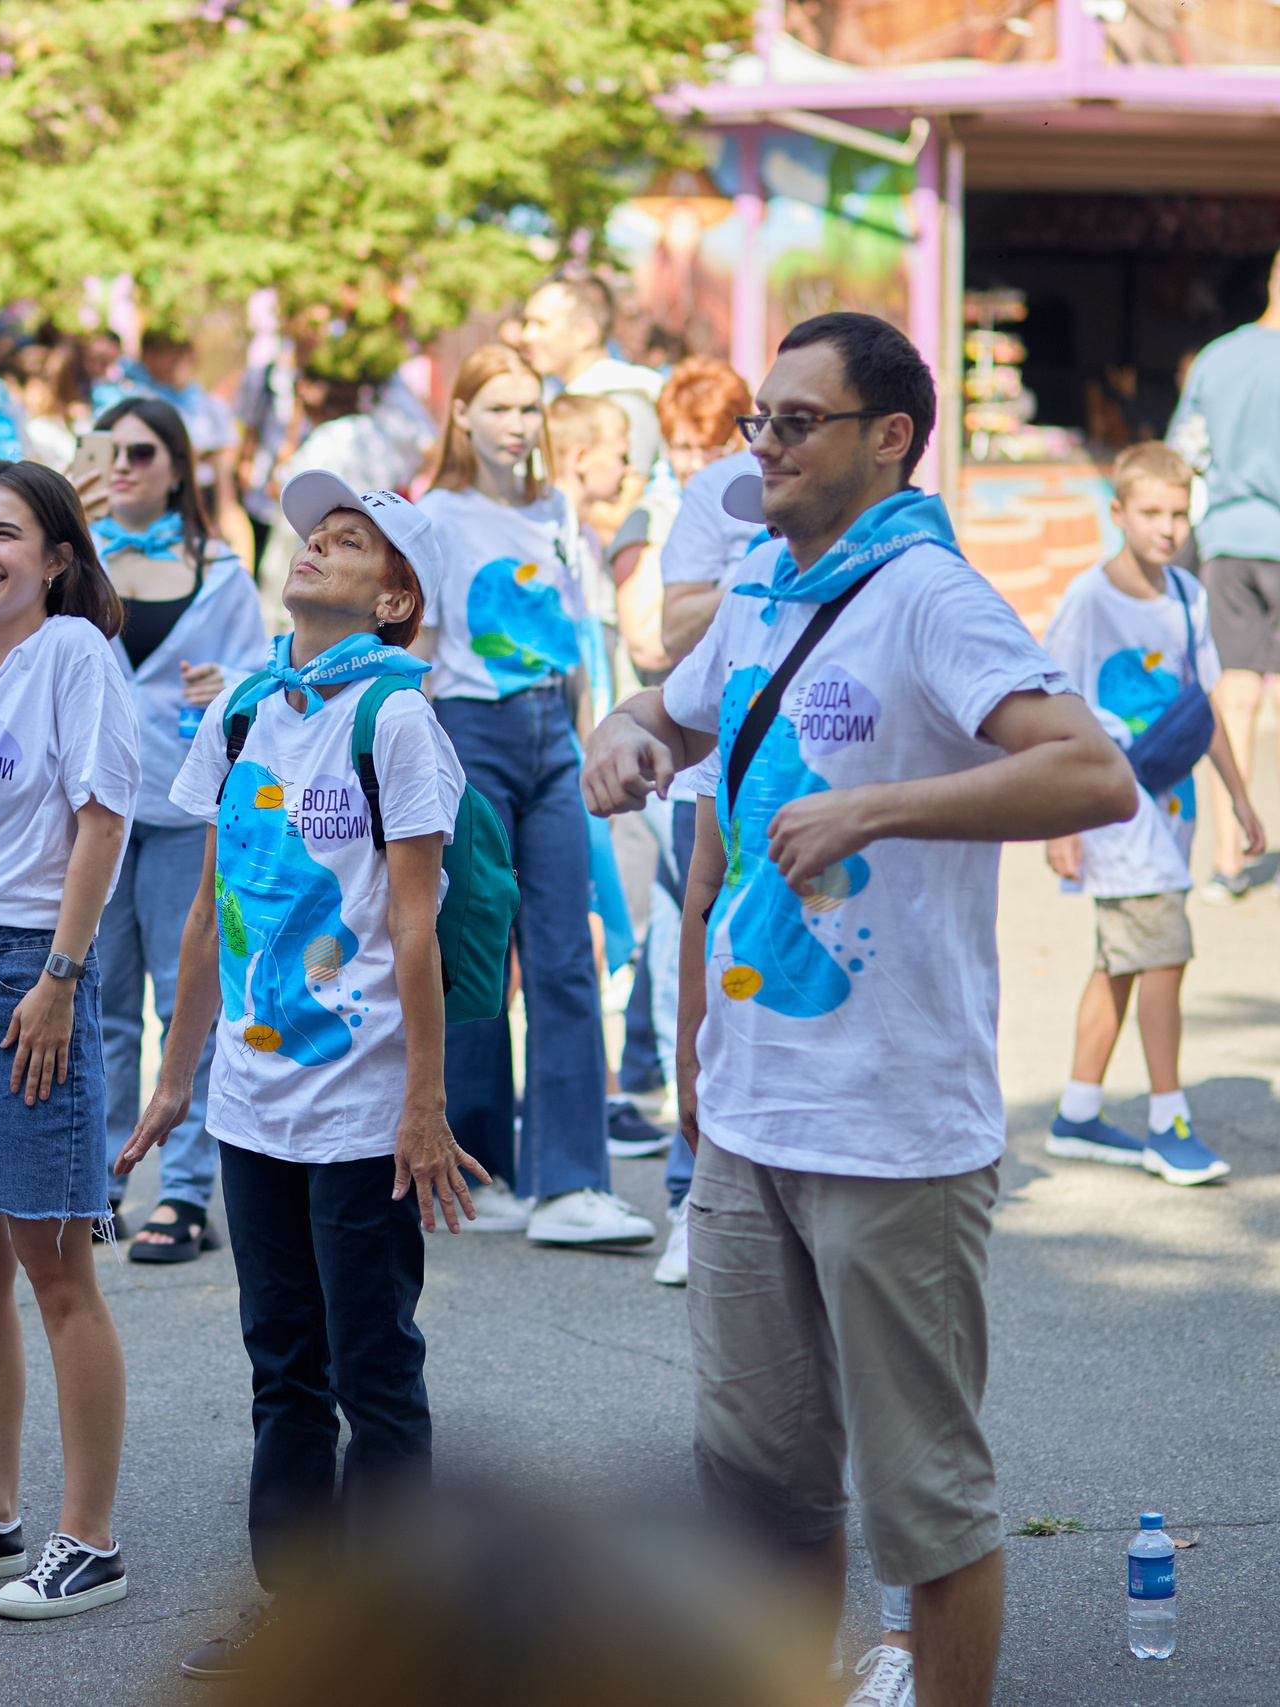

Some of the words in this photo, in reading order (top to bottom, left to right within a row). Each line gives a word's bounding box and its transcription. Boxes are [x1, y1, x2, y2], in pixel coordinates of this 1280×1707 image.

[805, 681, 851, 711] ВОДА
[799, 713, 874, 742] РОССИИ
[302, 788, 350, 814] ВОДА
[301, 816, 370, 840] РОССИИ
